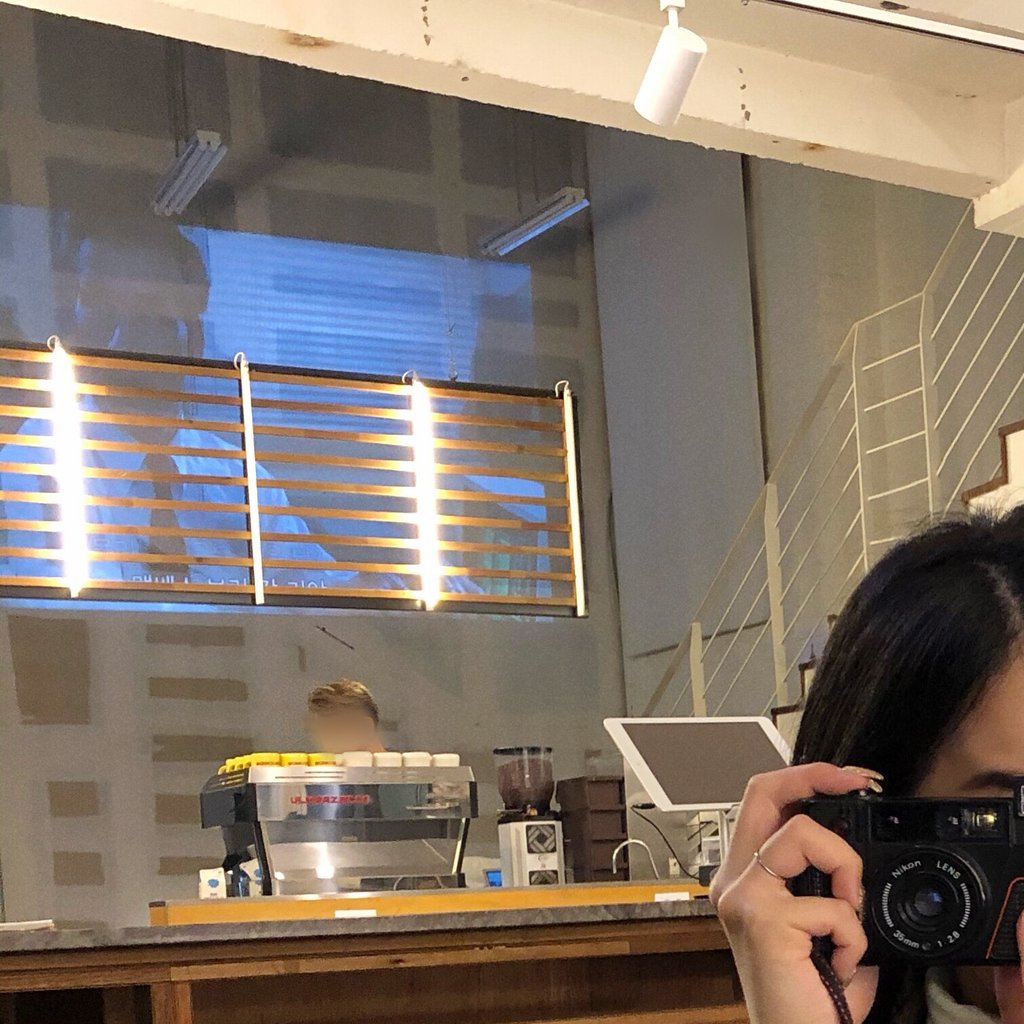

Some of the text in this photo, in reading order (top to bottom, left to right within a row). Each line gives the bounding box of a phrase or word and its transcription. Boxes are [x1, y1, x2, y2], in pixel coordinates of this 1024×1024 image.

[892, 861, 960, 879] Nikon LENS
[893, 930, 920, 948] 35mm
